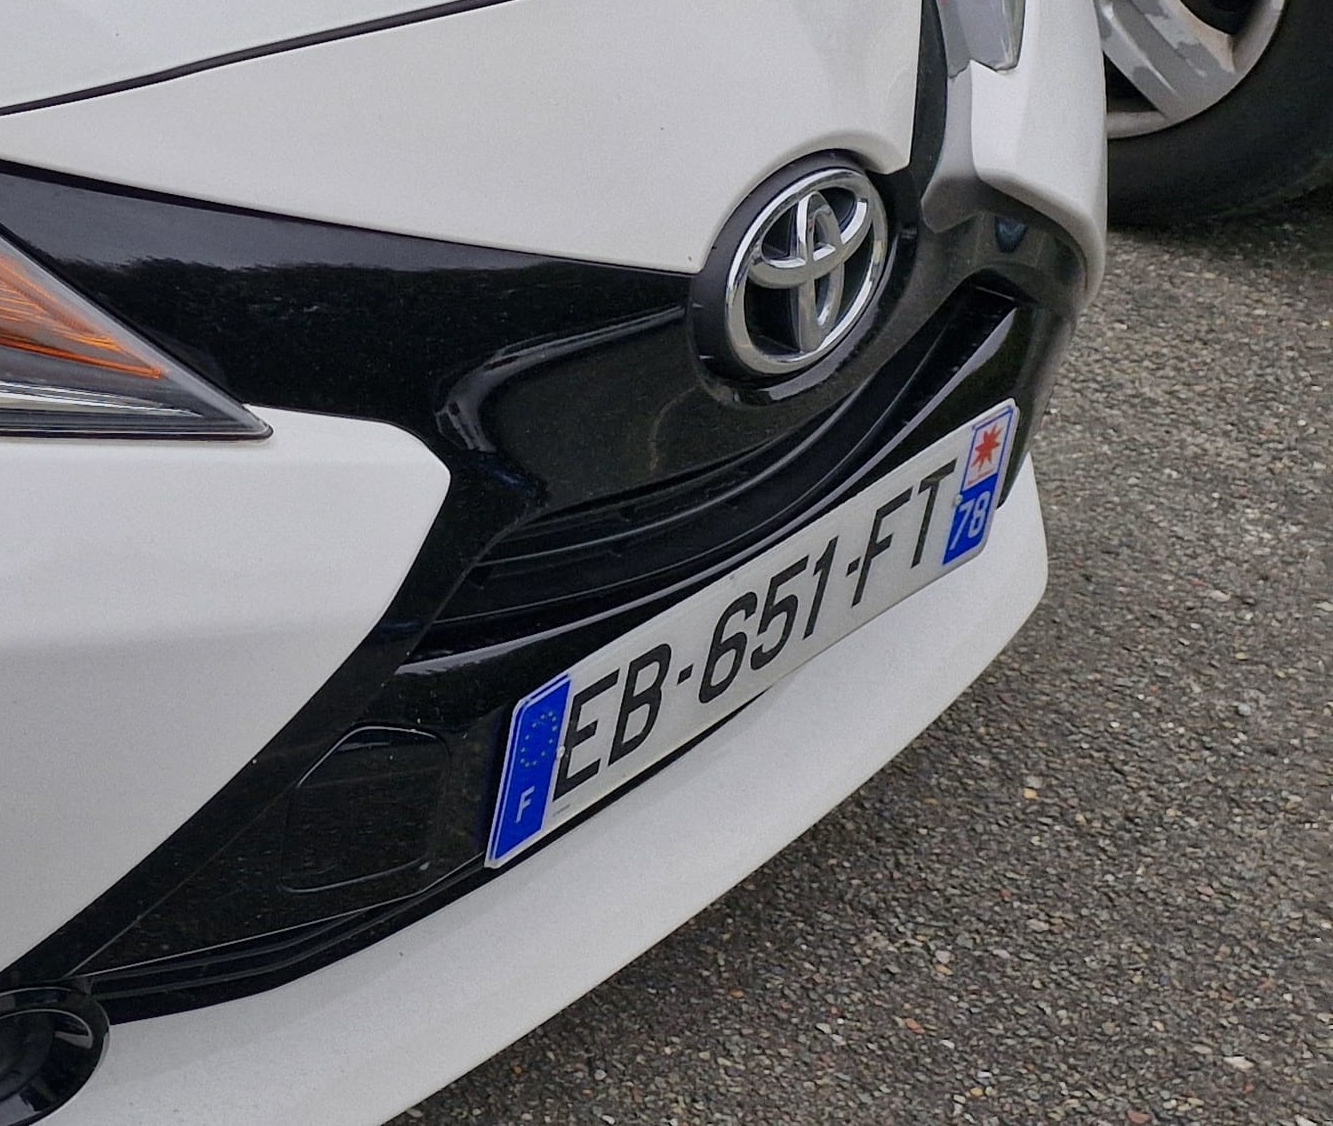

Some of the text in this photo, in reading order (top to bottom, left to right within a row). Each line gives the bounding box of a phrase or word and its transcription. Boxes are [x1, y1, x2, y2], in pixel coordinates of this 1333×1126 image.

[949, 490, 992, 551] 78
[553, 459, 957, 802] EB-651-FT
[515, 785, 536, 824] F
